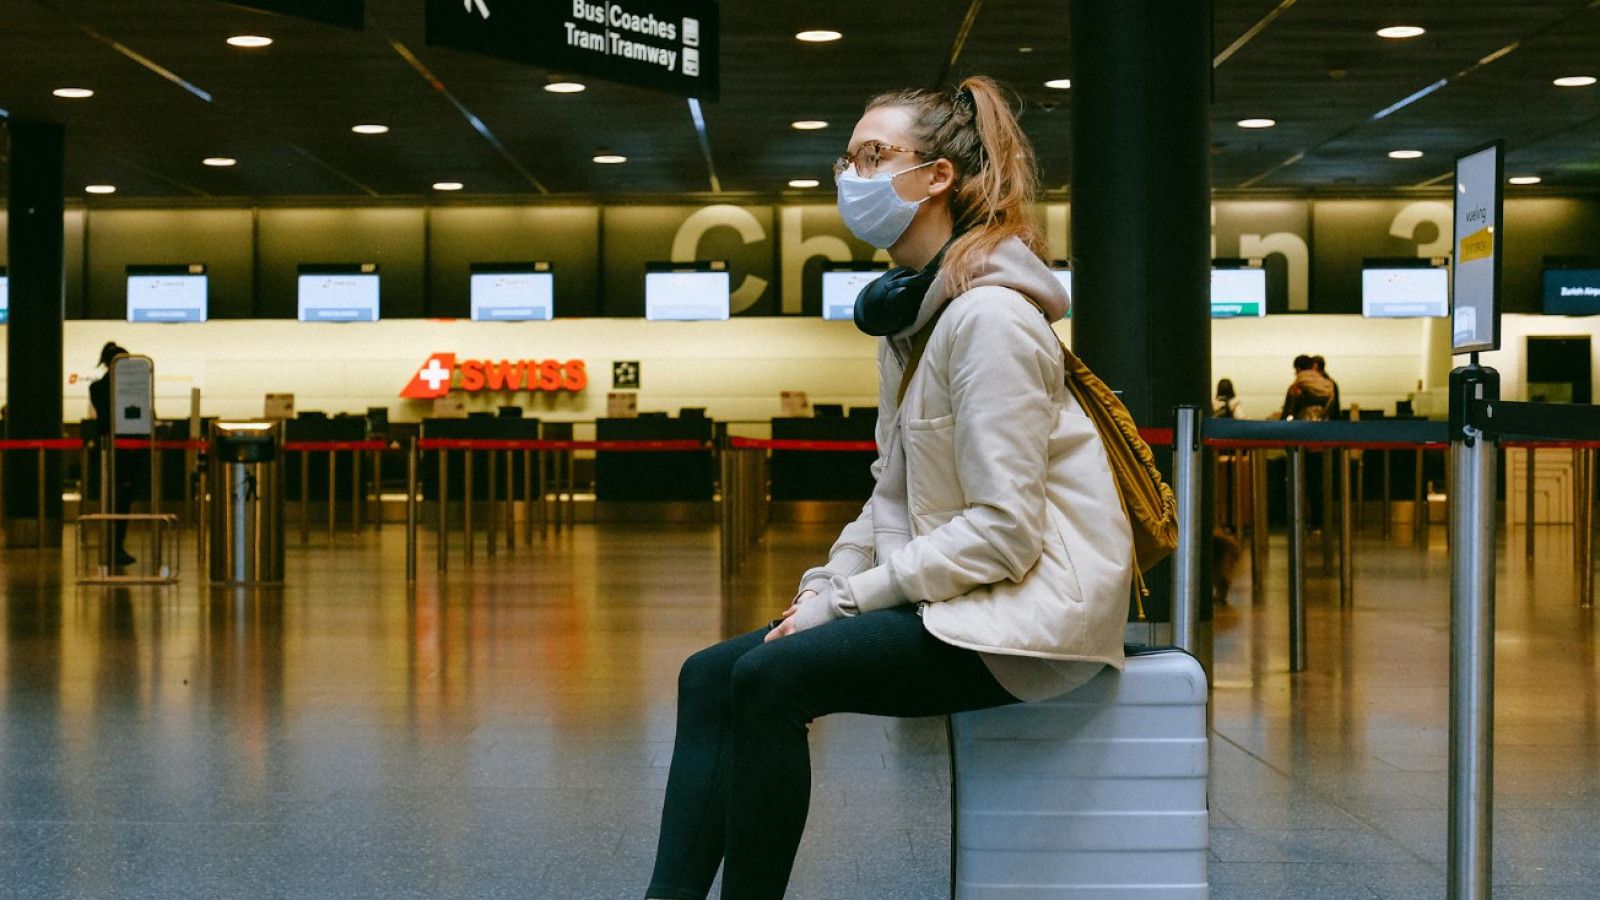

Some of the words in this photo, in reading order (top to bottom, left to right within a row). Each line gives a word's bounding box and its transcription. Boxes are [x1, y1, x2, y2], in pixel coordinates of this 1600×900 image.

[573, 0, 605, 24] Bus
[610, 5, 677, 40] Coaches
[564, 22, 605, 52] Tram
[610, 32, 677, 71] Tramway
[460, 359, 588, 392] SWISS
